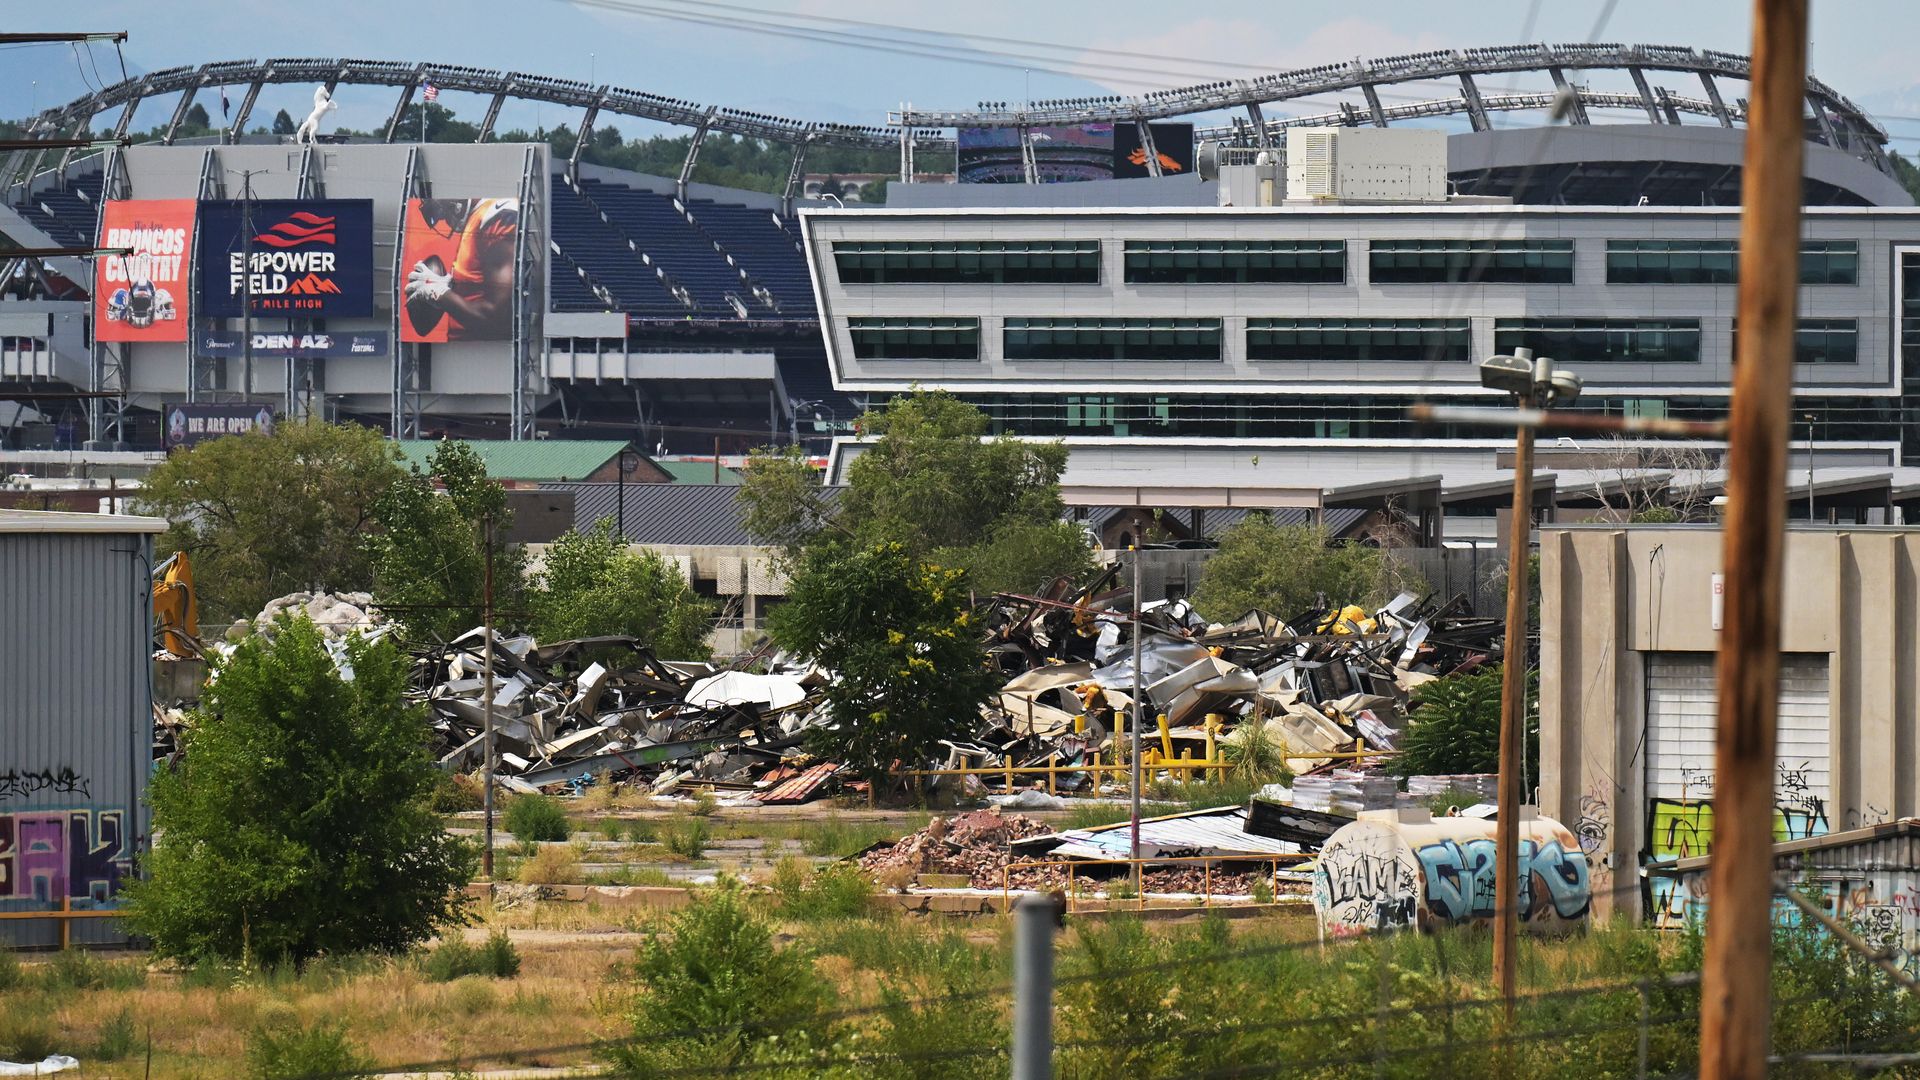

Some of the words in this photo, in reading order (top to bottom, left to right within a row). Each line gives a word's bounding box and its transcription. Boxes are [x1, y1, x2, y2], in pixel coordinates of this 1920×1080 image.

[106, 228, 186, 255] BRONCOS
[105, 254, 182, 282] COUNTRY
[230, 274, 288, 295] FELD
[263, 300, 290, 308] MILE
[295, 300, 322, 308] HIGH
[252, 335, 293, 348] DEN
[300, 335, 329, 348] AZ
[188, 417, 203, 433] WE
[206, 417, 225, 433] ARE
[228, 417, 252, 434] OPEN
